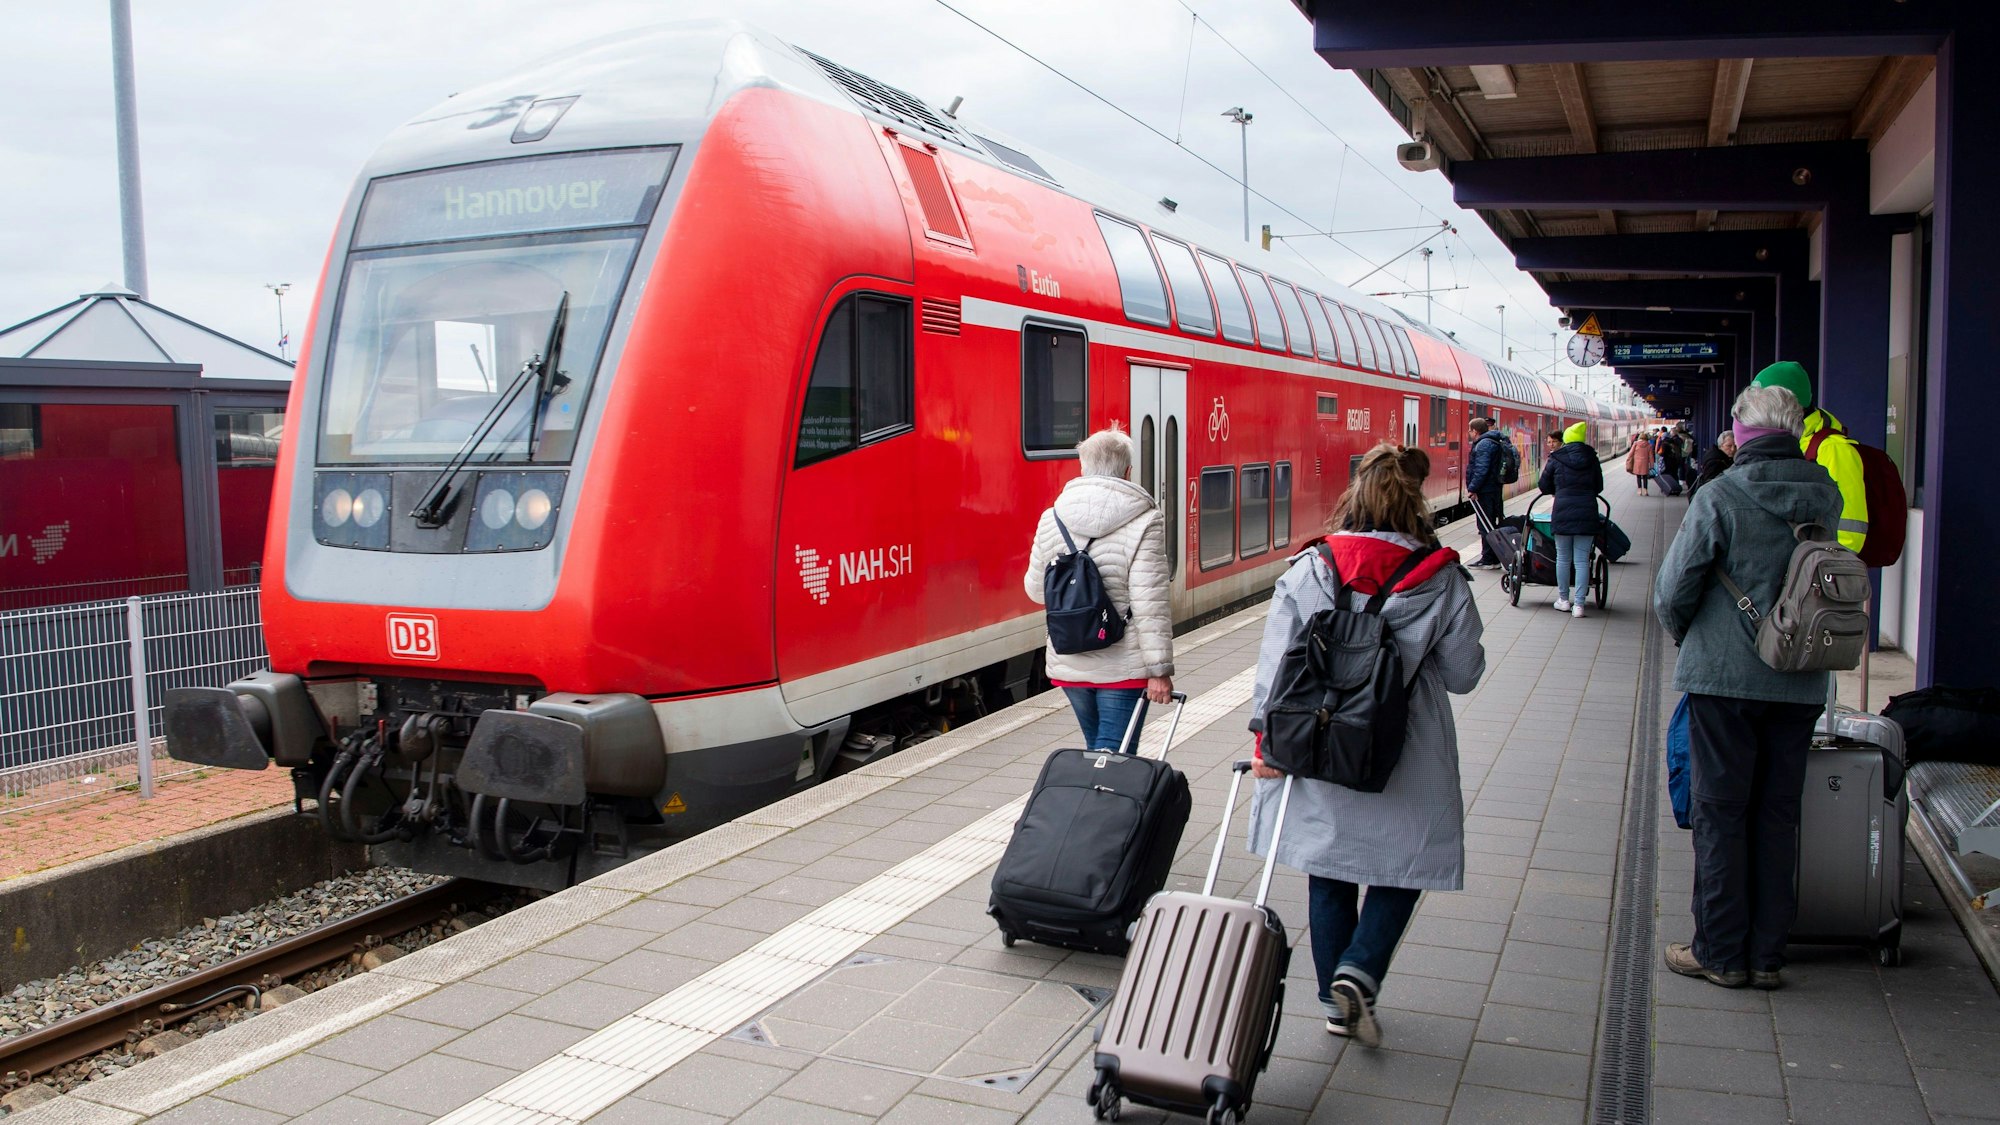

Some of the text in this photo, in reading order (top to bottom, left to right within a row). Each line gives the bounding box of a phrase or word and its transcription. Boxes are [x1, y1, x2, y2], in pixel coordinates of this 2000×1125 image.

[445, 178, 605, 220] Hannover
[1031, 269, 1060, 299] Eutin
[1642, 347, 1671, 355] Hannover
[1346, 408, 1364, 431] REGIO
[1684, 407, 1691, 415] B
[1189, 480, 1197, 513] 2
[839, 543, 912, 586] NAH.SH
[393, 619, 433, 654] DB
